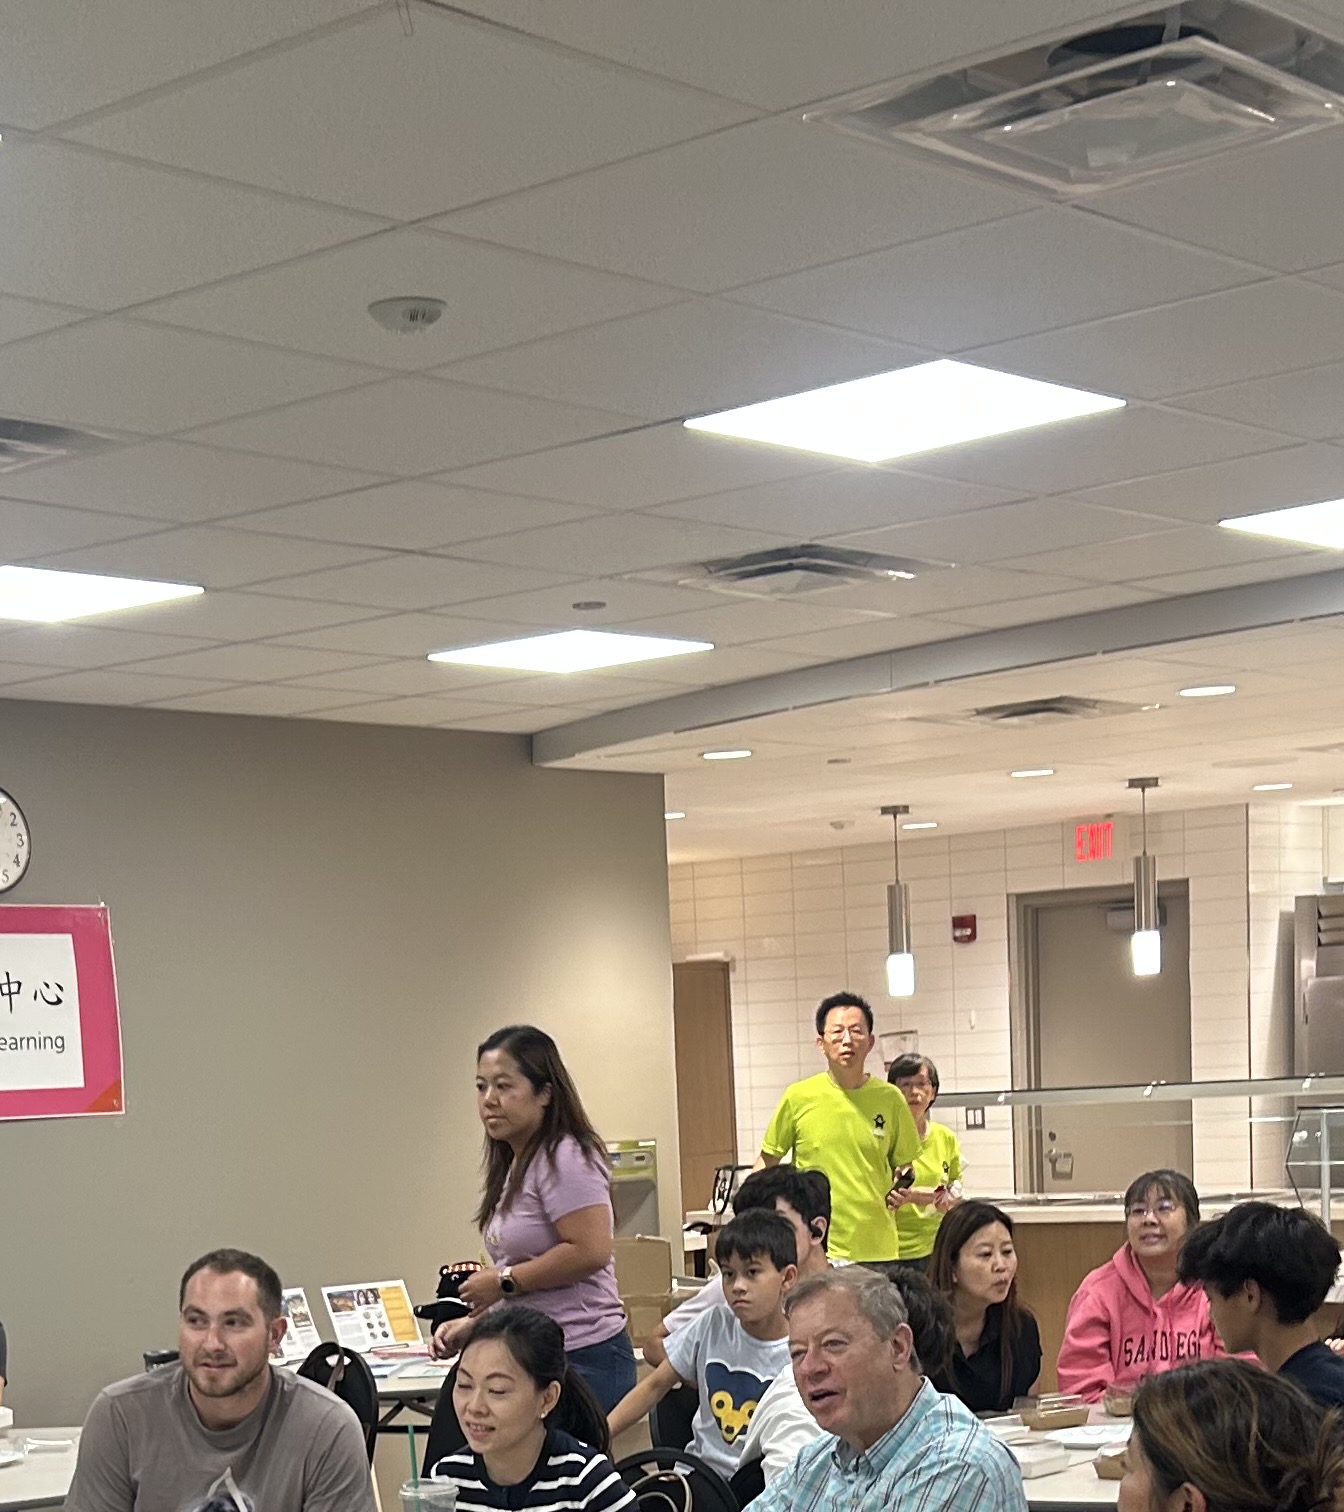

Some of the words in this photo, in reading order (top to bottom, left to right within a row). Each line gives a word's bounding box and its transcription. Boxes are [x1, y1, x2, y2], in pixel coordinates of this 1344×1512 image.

[10, 812, 17, 826] 2
[17, 833, 24, 848] 3
[1076, 823, 1114, 862] EXIT
[13, 854, 20, 867] 4
[2, 869, 9, 883] 5
